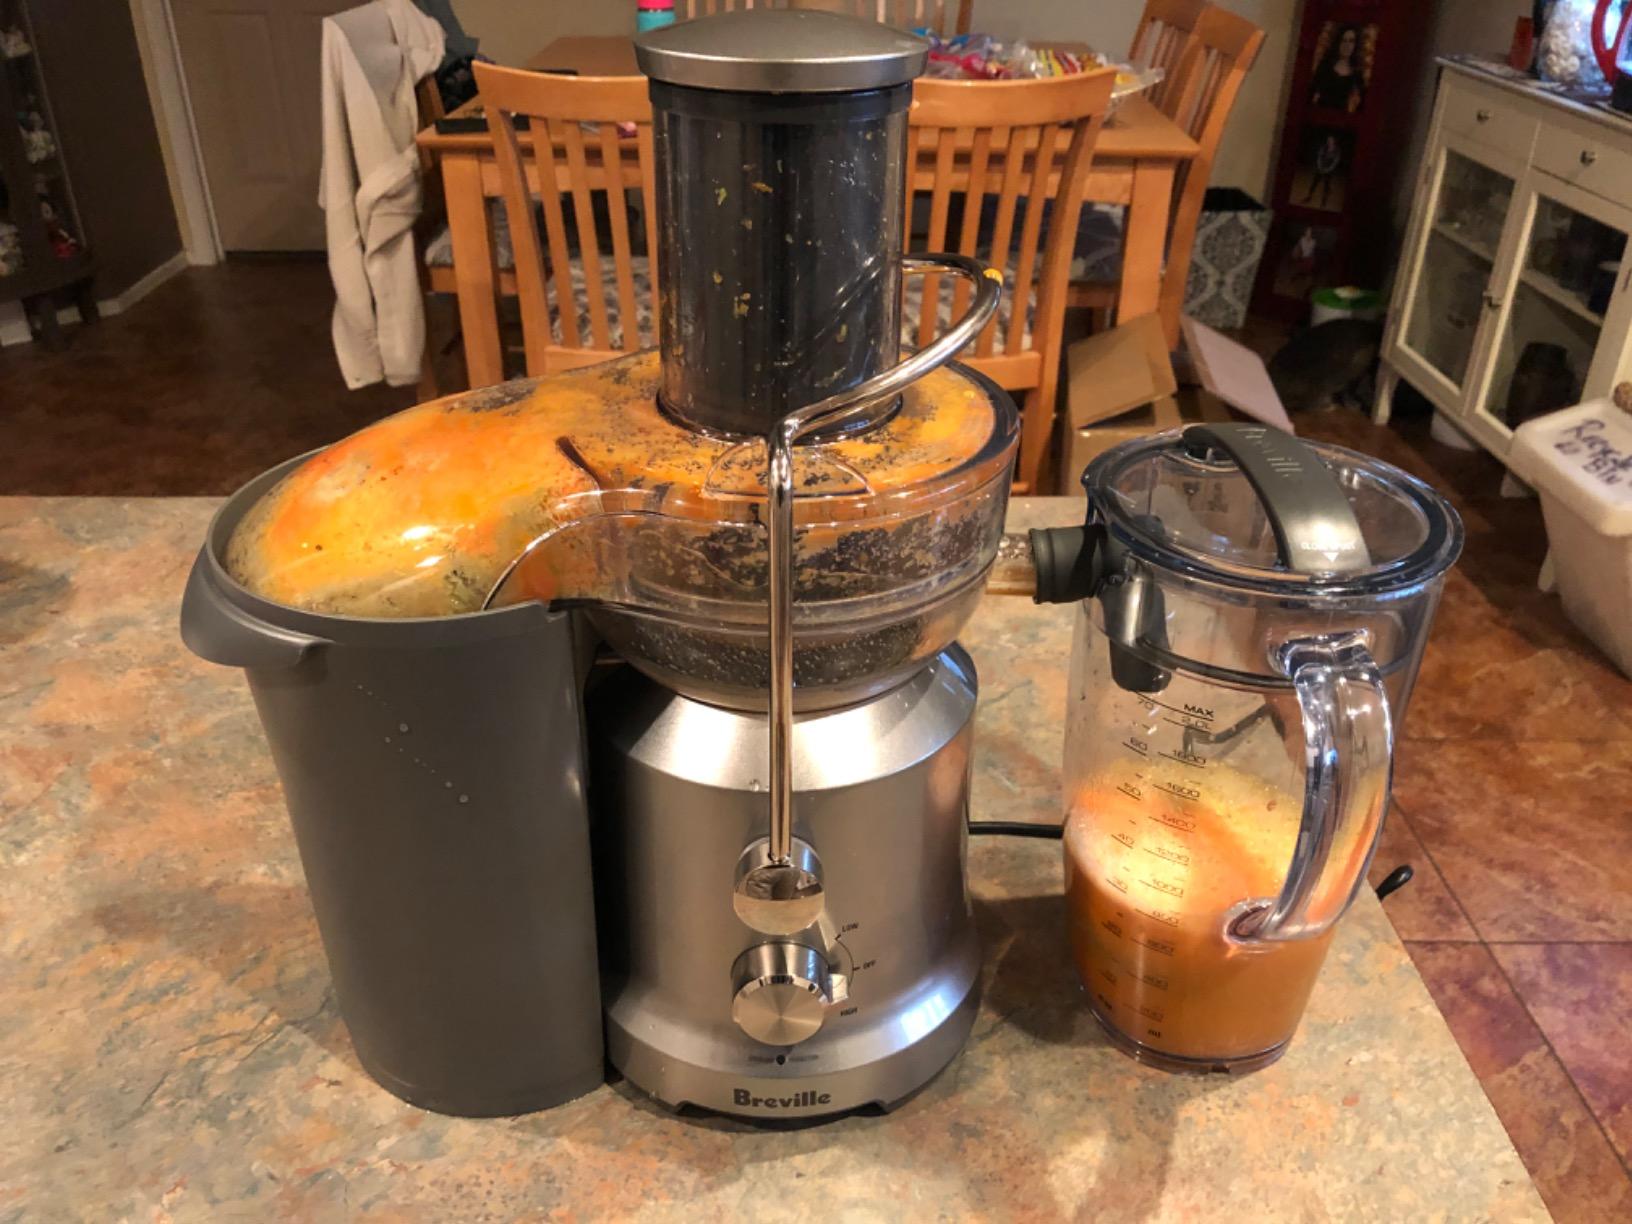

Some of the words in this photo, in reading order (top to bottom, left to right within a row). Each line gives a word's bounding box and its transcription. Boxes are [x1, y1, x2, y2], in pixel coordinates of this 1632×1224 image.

[1183, 703, 1214, 718] MAX
[842, 922, 859, 933] LOW
[733, 1088, 831, 1108] Breville
